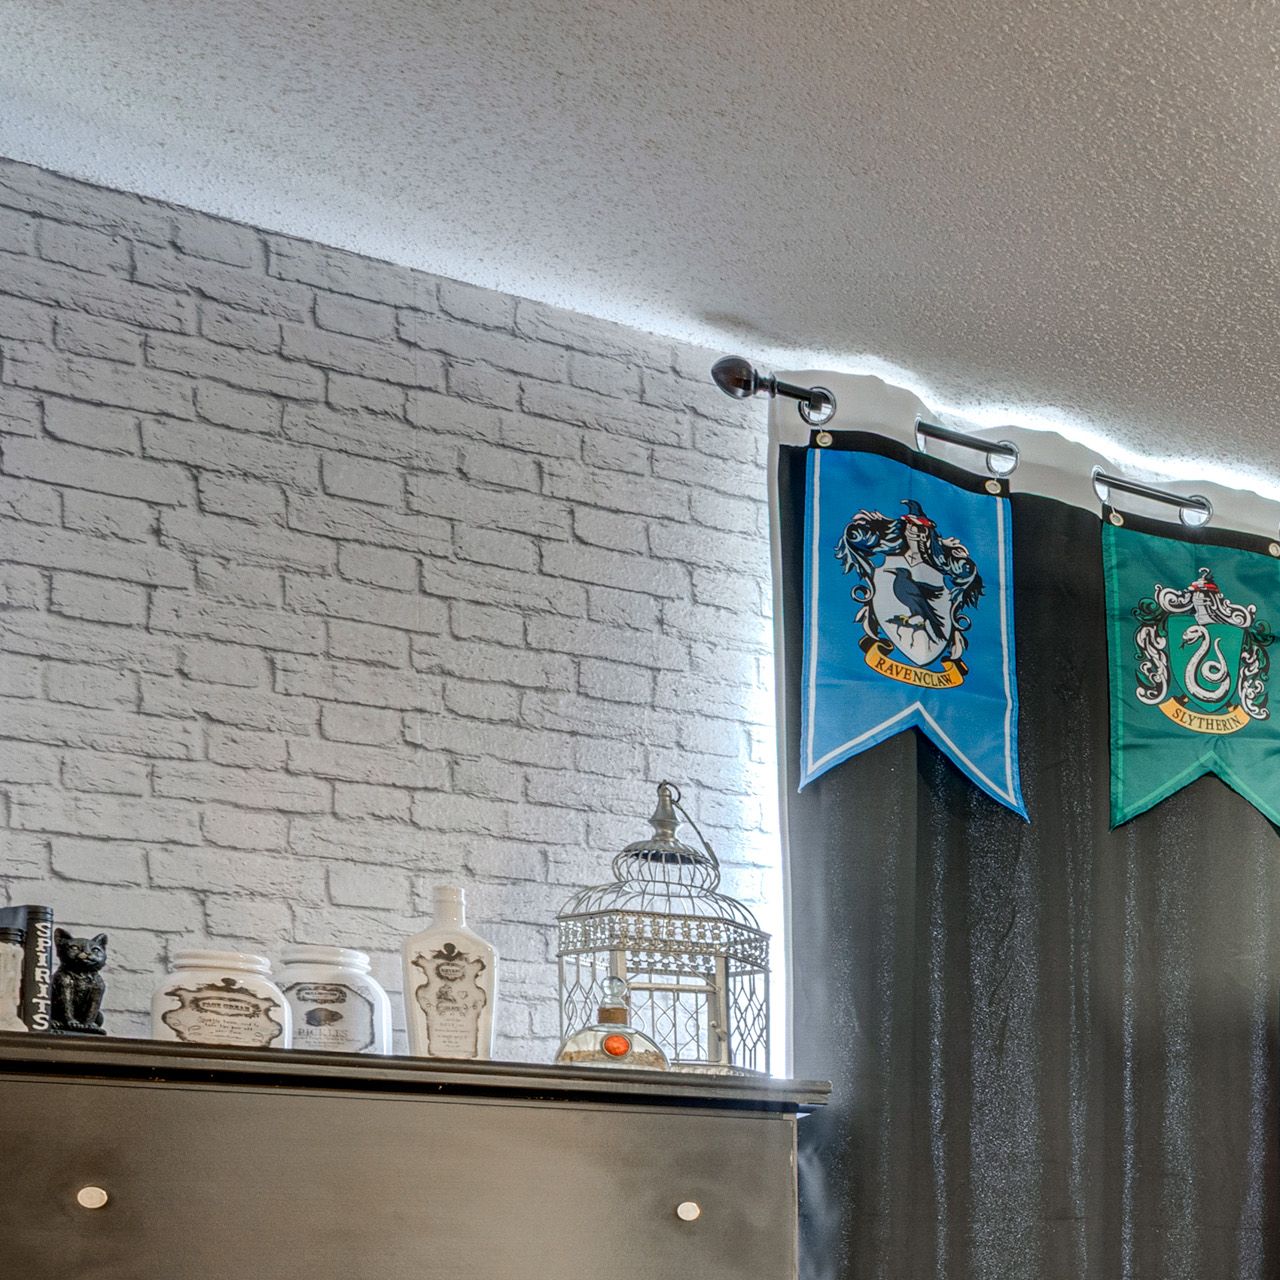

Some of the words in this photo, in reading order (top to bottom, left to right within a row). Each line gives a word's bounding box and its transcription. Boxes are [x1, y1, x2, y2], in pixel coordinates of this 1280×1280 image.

[874, 657, 954, 688] RAVENCLAW
[1172, 708, 1241, 732] SLYTHERIN
[32, 922, 51, 1031] SPIRITS
